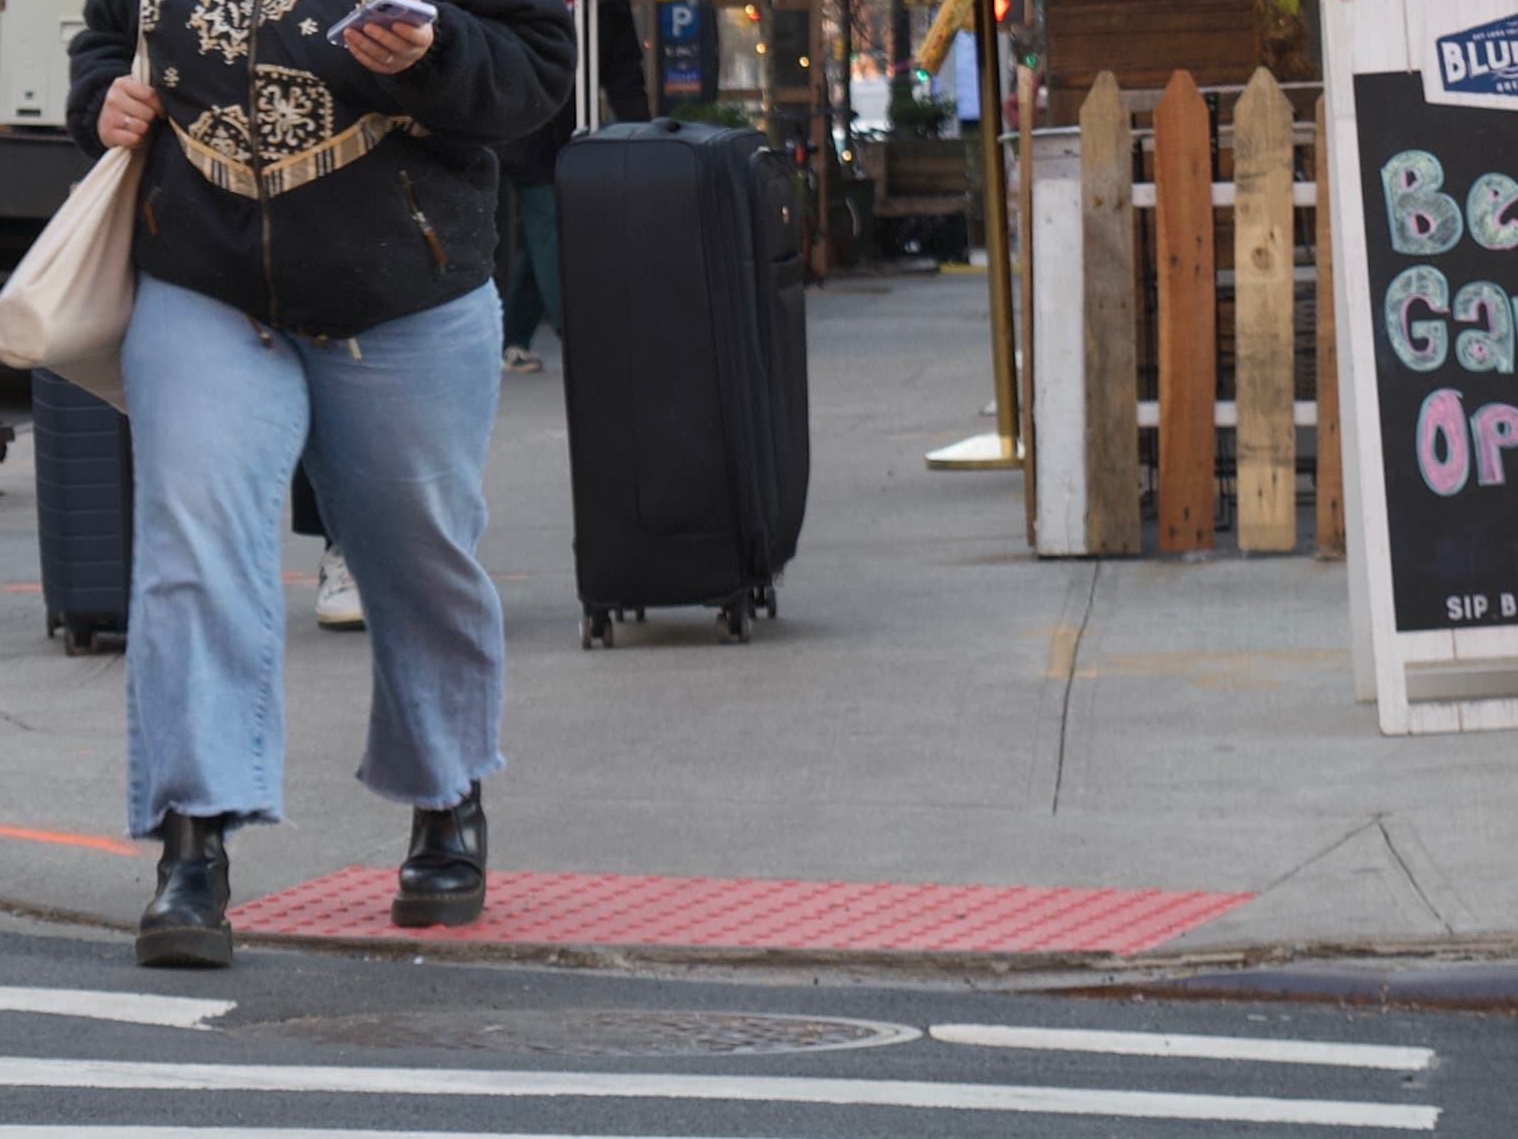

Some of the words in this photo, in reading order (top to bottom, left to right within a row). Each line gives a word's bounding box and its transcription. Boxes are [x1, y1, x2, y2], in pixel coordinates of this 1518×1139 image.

[672, 6, 693, 37] P
[1380, 149, 1518, 255] Be
[1384, 264, 1518, 374] Ga
[1446, 593, 1489, 621] SIP
